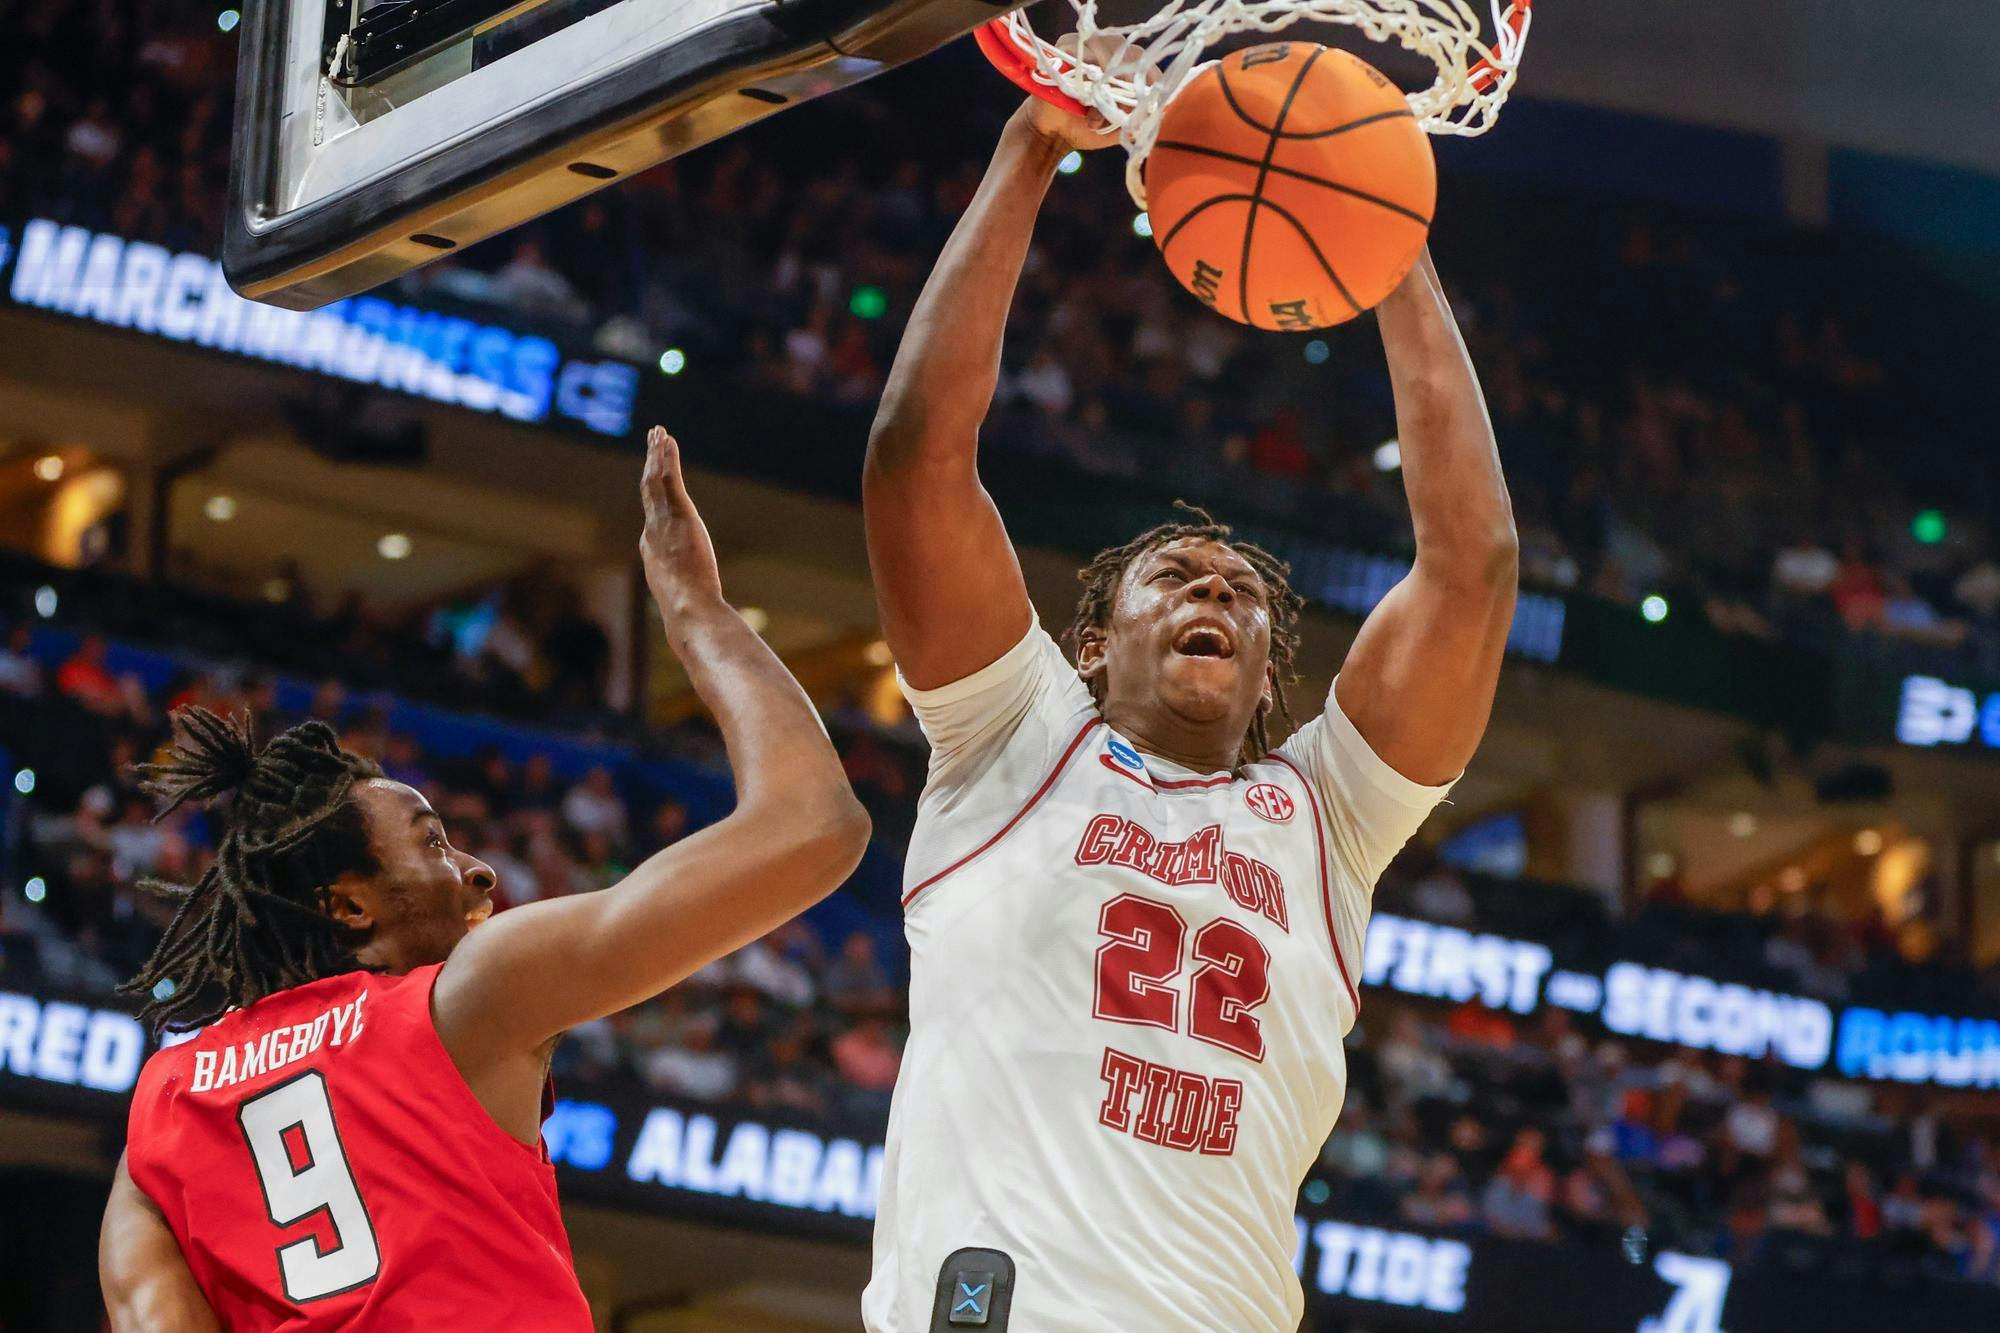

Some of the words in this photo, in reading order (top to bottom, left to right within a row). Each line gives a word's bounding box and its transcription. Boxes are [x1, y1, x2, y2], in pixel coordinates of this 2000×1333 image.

[1247, 785, 1292, 821] SEC
[1092, 892, 1271, 1063] 22
[1364, 912, 1552, 1014] FIRST
[1603, 963, 1831, 1067] SECOND
[0, 991, 145, 1092] RED
[190, 989, 367, 1092] BAMGBOYE
[1098, 1046, 1243, 1156] TIDE
[236, 1068, 381, 1304] 9
[1314, 1220, 1472, 1313] TIDE
